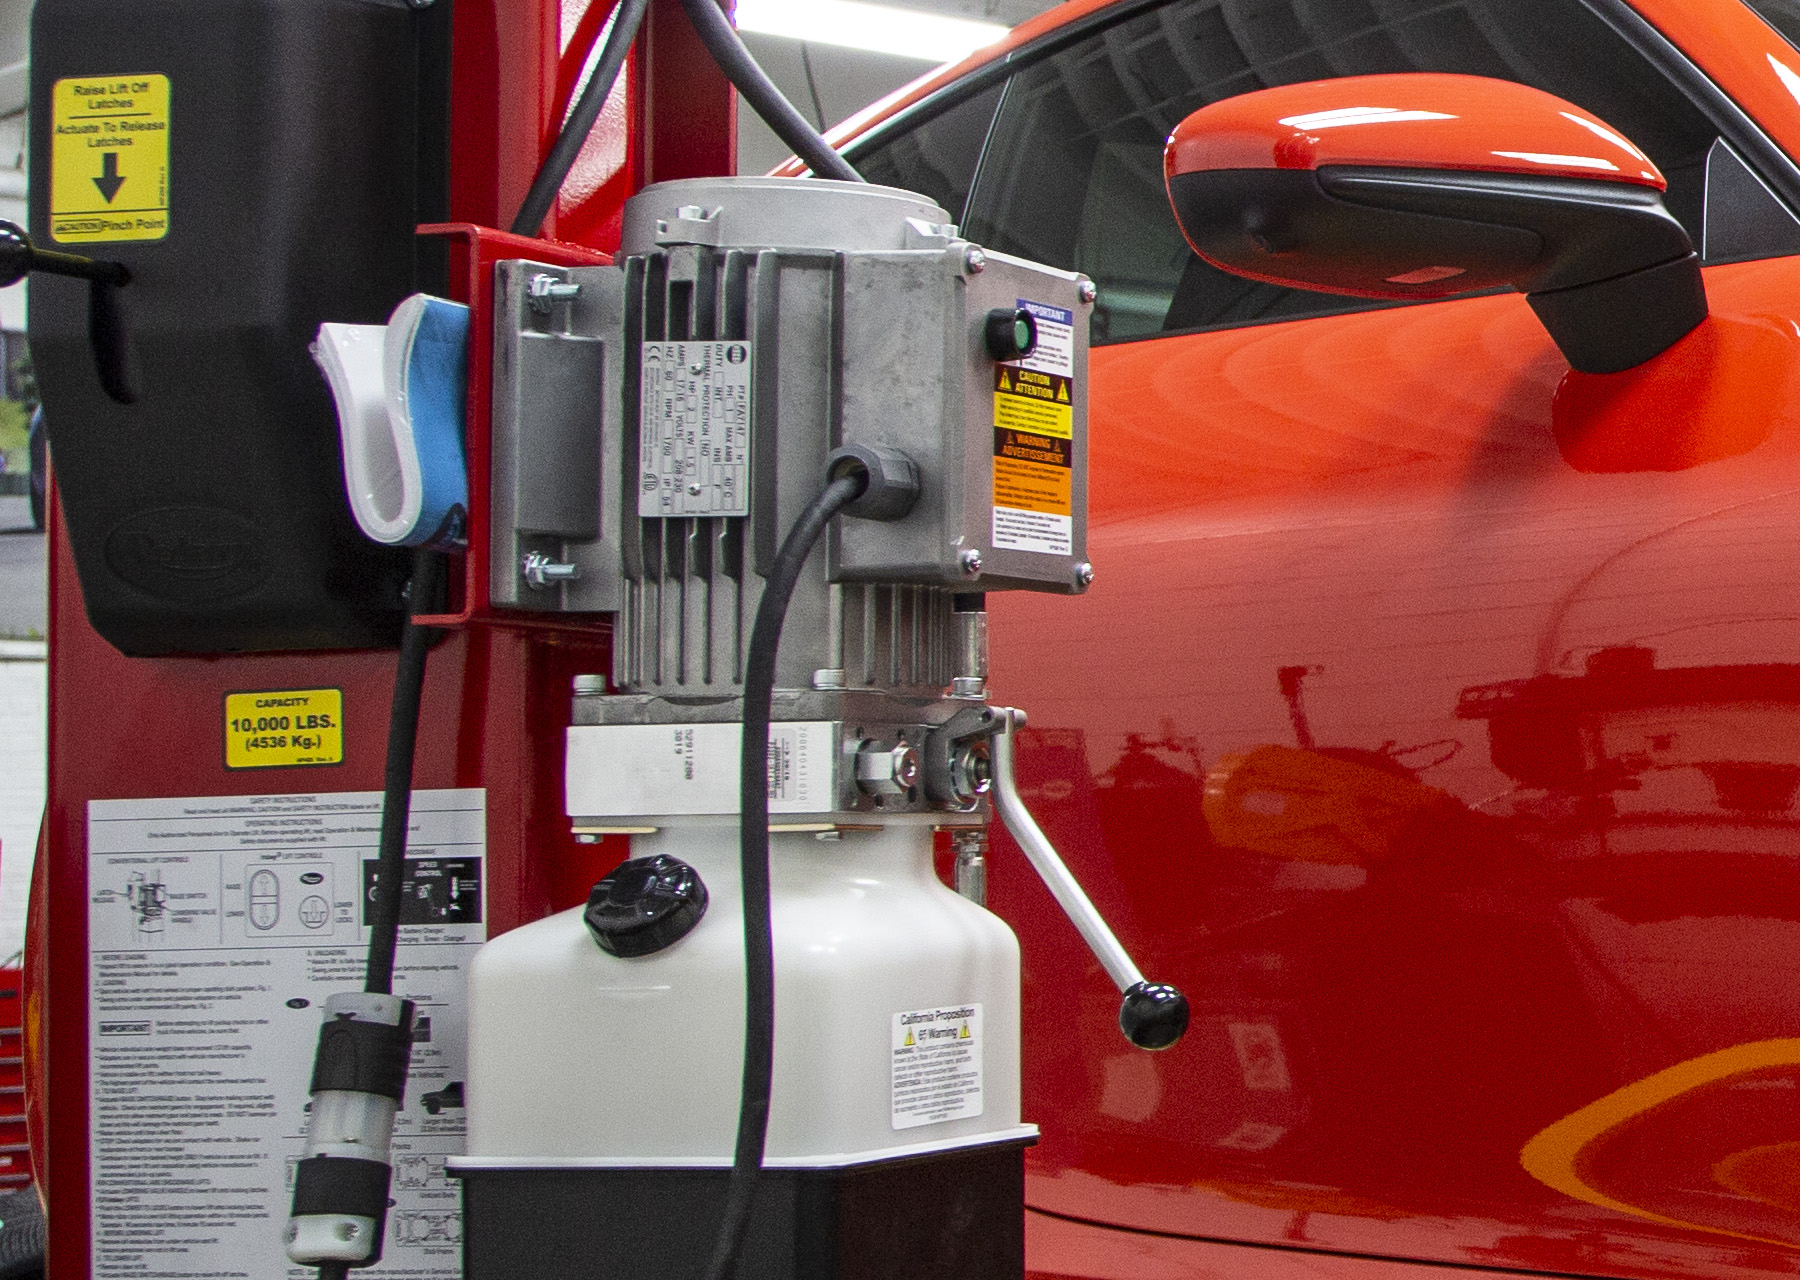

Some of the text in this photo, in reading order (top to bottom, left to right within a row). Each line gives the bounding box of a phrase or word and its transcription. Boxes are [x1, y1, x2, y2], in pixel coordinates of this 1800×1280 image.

[73, 81, 149, 96] Raise Lift Off
[88, 98, 134, 110] Latches
[56, 120, 165, 135] Actuate To Release
[87, 136, 133, 148] Latches
[101, 219, 132, 231] Pinch
[136, 218, 165, 230] Point
[1024, 302, 1066, 322] IMPORTANT
[703, 345, 711, 381] THERMAL
[1019, 369, 1051, 386] CAUTION
[1014, 382, 1054, 400] ATTENTION
[665, 398, 673, 418] RPM
[702, 385, 710, 436] PROTECTION
[676, 415, 684, 437] VOLTS
[688, 431, 695, 445] KW
[1016, 433, 1052, 449] WARNING
[714, 448, 722, 462] INS
[255, 697, 310, 708] CAPACITY
[230, 714, 336, 734] 10,000 LBS.
[244, 733, 322, 753] (4536 Kg.)
[900, 1007, 975, 1026] California Proposition
[928, 1026, 958, 1040] Warning
